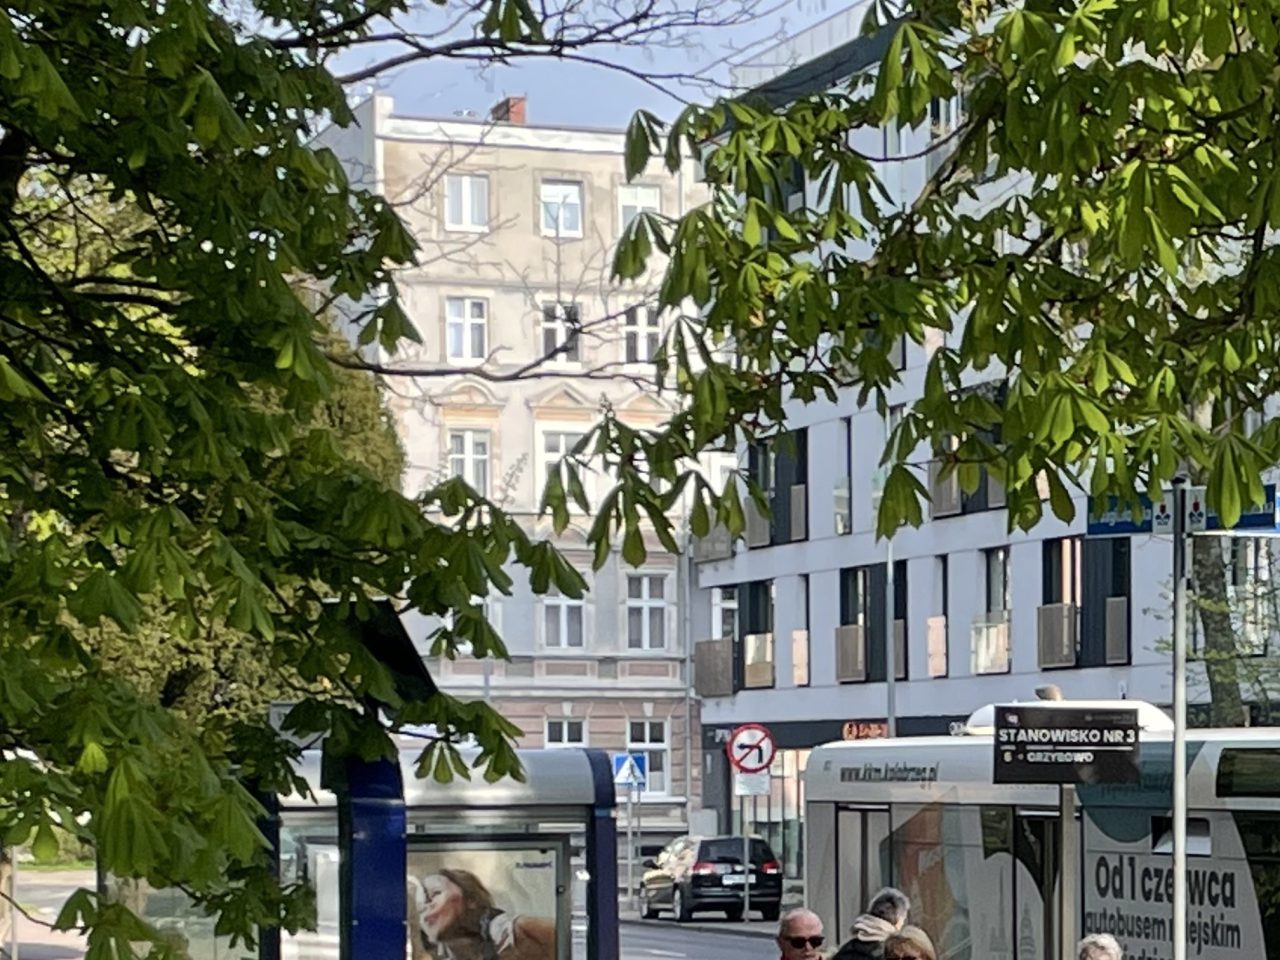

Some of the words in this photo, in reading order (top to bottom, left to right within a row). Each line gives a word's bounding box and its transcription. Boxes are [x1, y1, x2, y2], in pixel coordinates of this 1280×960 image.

[999, 728, 1101, 743] STANOWISKO
[1103, 729, 1124, 743] NR
[1126, 730, 1136, 743] 3
[1026, 751, 1094, 763] GRZYBOWO
[1095, 855, 1124, 899] Od
[1128, 856, 1136, 900] 1
[1141, 866, 1236, 908] czewca
[1085, 906, 1166, 942] autobusem
